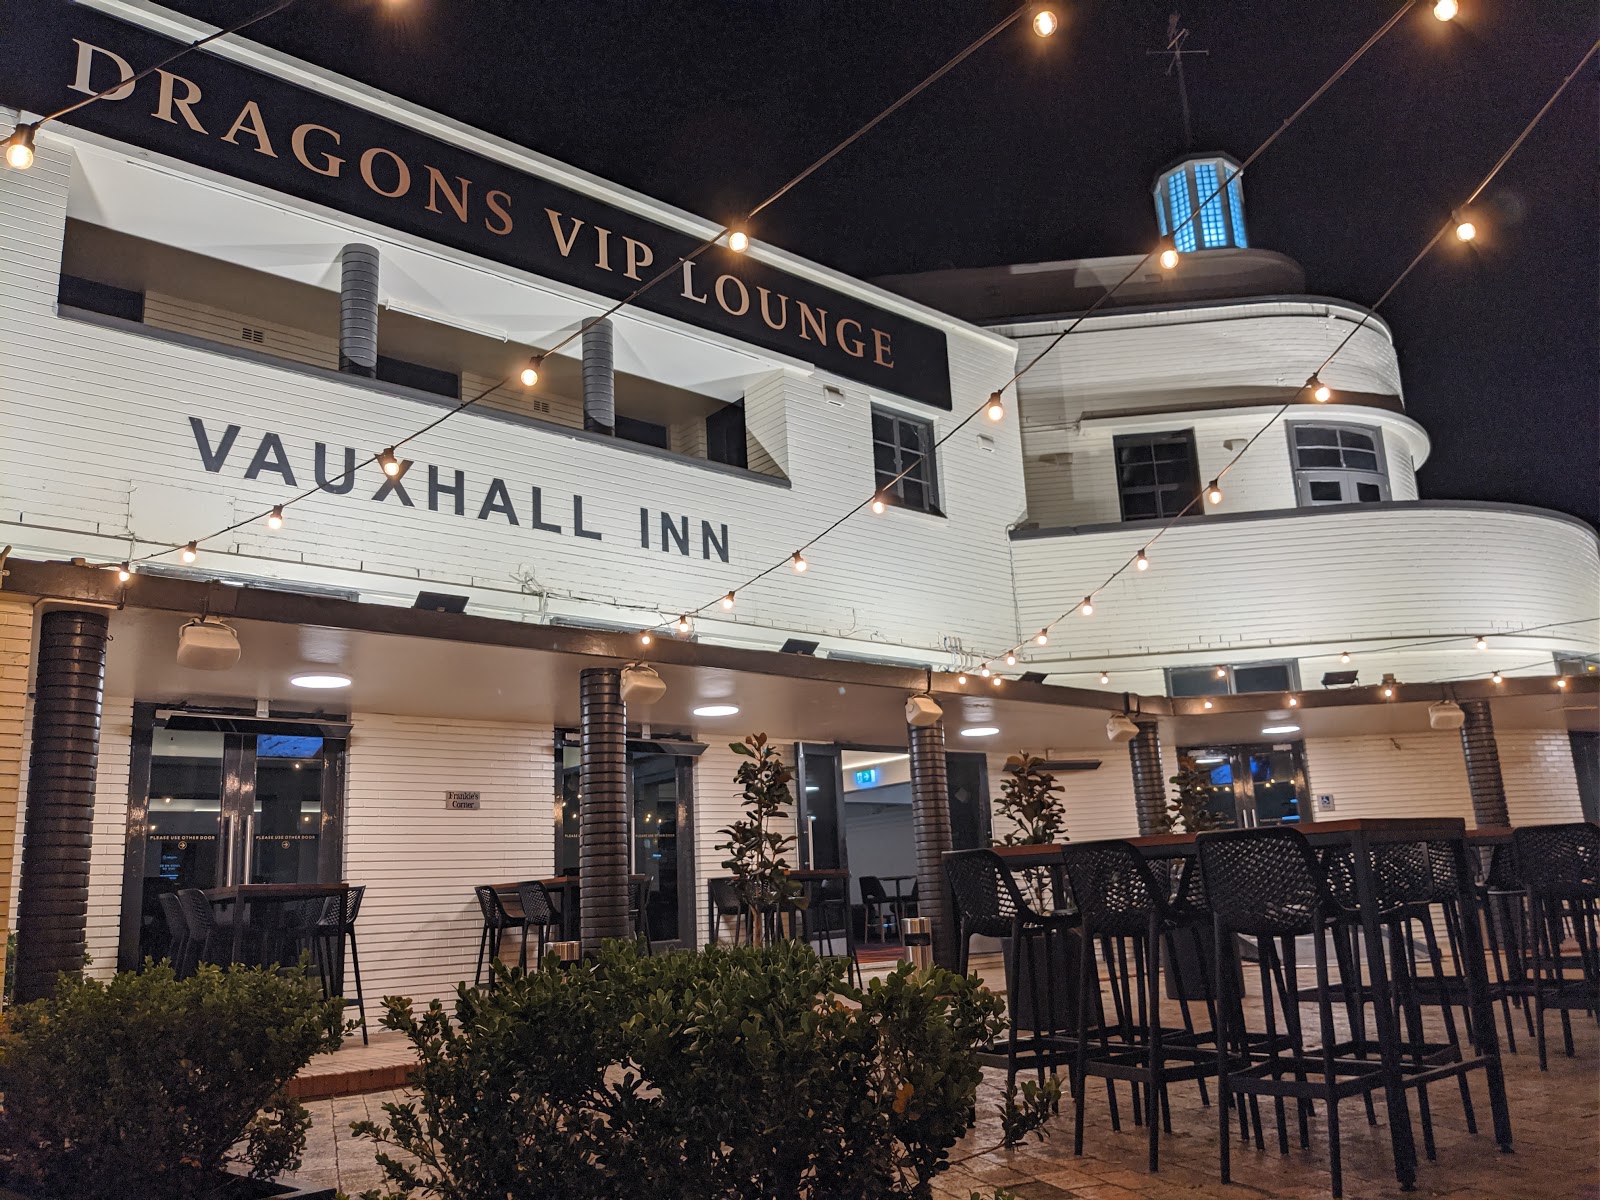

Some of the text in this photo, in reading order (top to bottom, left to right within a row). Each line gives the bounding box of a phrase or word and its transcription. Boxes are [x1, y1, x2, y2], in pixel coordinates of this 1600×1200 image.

[67, 38, 895, 368] DRAGONS VIP LOUNGE
[188, 416, 730, 563] VAUXHALL INN
[448, 791, 479, 800] Frankie's
[452, 800, 475, 809] Corner
